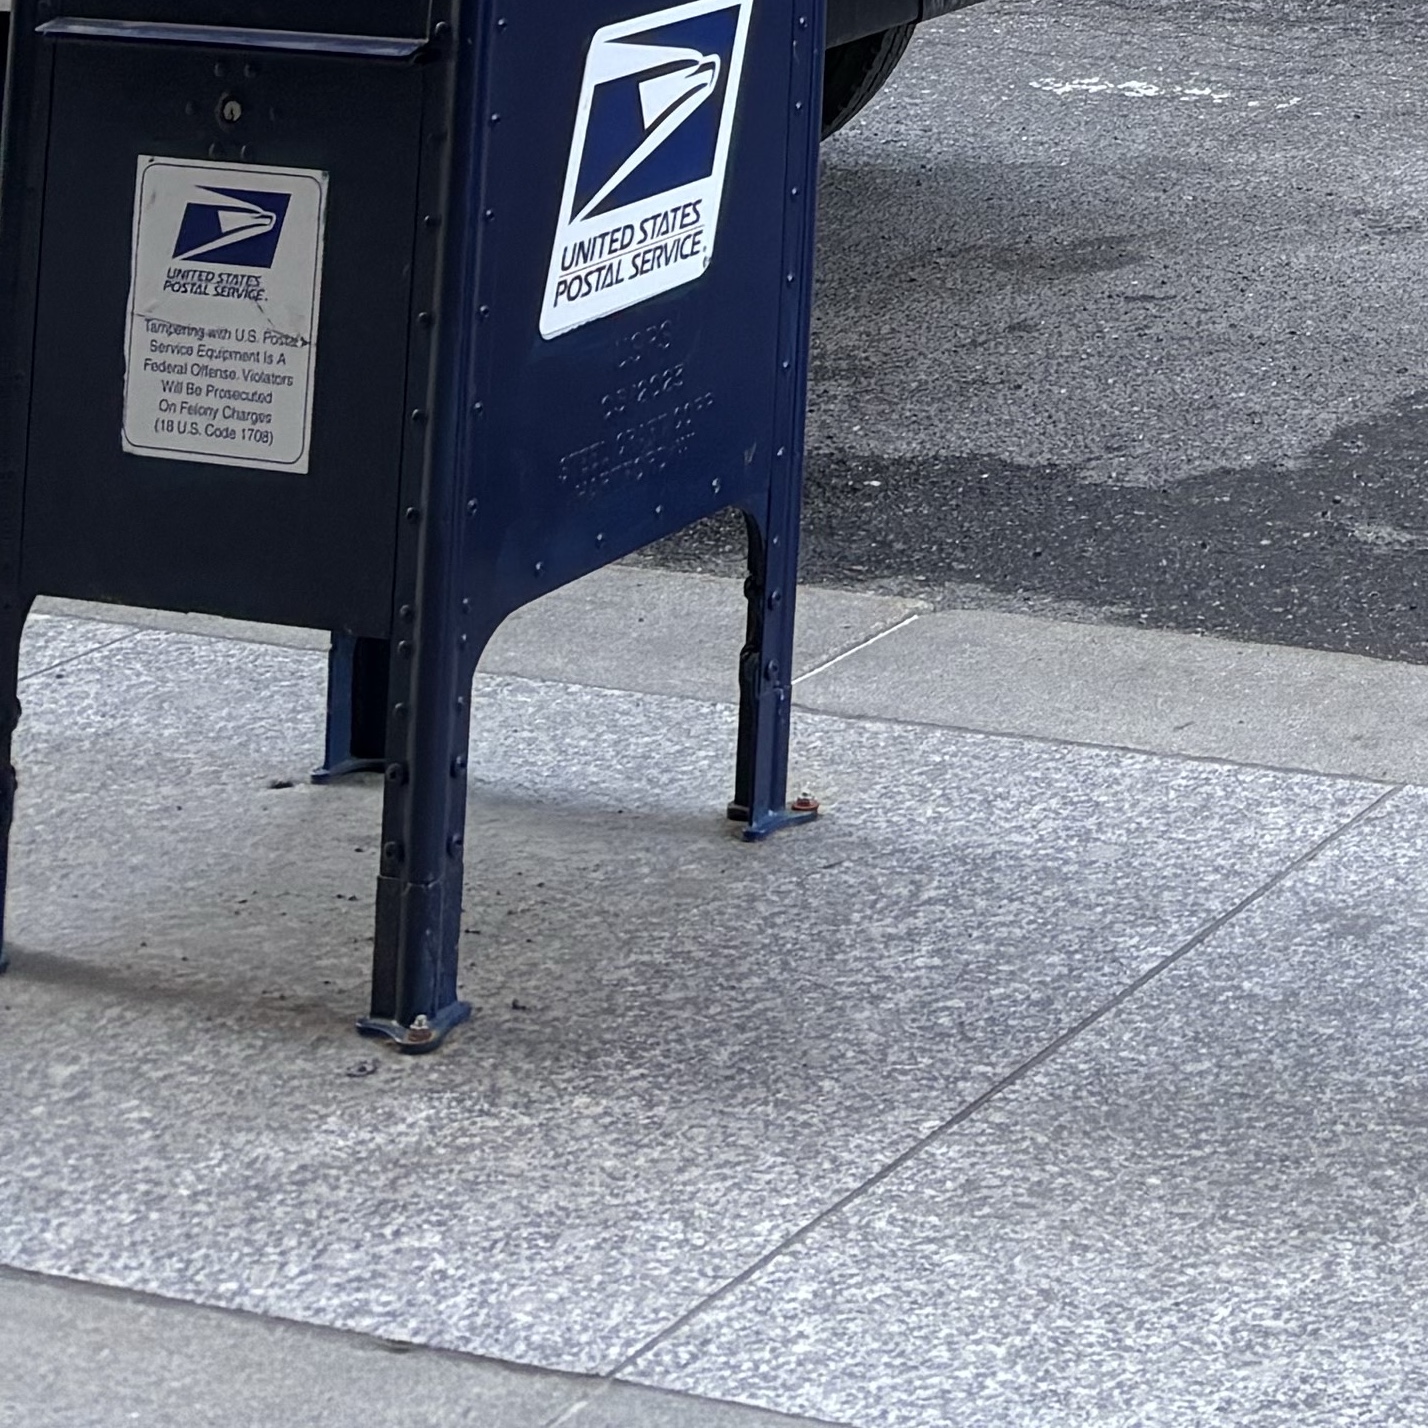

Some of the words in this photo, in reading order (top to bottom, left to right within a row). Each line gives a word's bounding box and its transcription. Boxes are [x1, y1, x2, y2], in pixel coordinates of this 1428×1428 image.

[561, 223, 635, 272] UNITED
[637, 199, 703, 244] STATES
[163, 281, 211, 297] POSTAL
[166, 267, 213, 284] UNITED
[216, 271, 262, 287] STATES
[553, 260, 624, 308] POSTAL
[144, 317, 206, 341] Tampering
[150, 340, 194, 357] Service
[197, 344, 260, 364] Equipment
[276, 351, 286, 365] A
[144, 358, 188, 375] Federal
[242, 366, 293, 386] Violators
[161, 379, 183, 394] Will
[187, 381, 202, 396] Be
[206, 384, 273, 404] Prosecuted
[159, 398, 176, 413] On
[180, 401, 218, 420] Felony
[222, 405, 272, 424] Charges
[154, 417, 174, 434] (18
[177, 421, 202, 436] U.S.
[204, 422, 237, 440] Code
